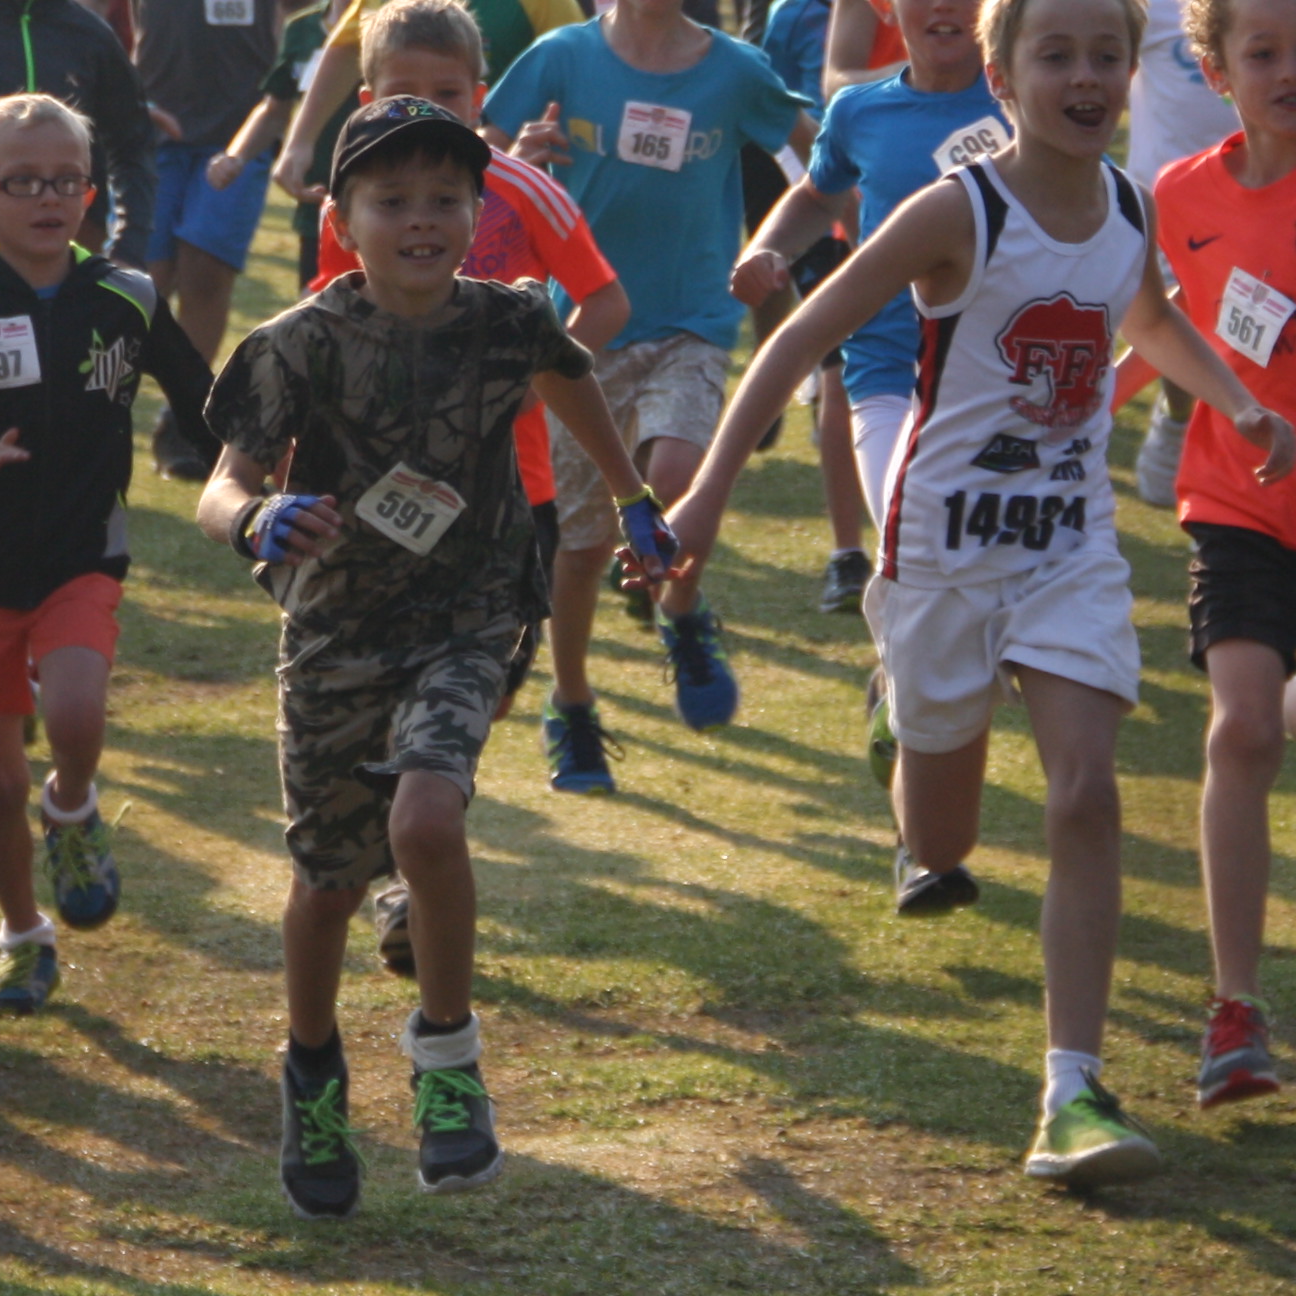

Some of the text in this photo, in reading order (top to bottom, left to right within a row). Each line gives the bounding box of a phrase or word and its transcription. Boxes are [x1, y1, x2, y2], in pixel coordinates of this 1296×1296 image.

[632, 132, 673, 161] 165
[1226, 305, 1267, 352] 561
[375, 489, 438, 540] 591
